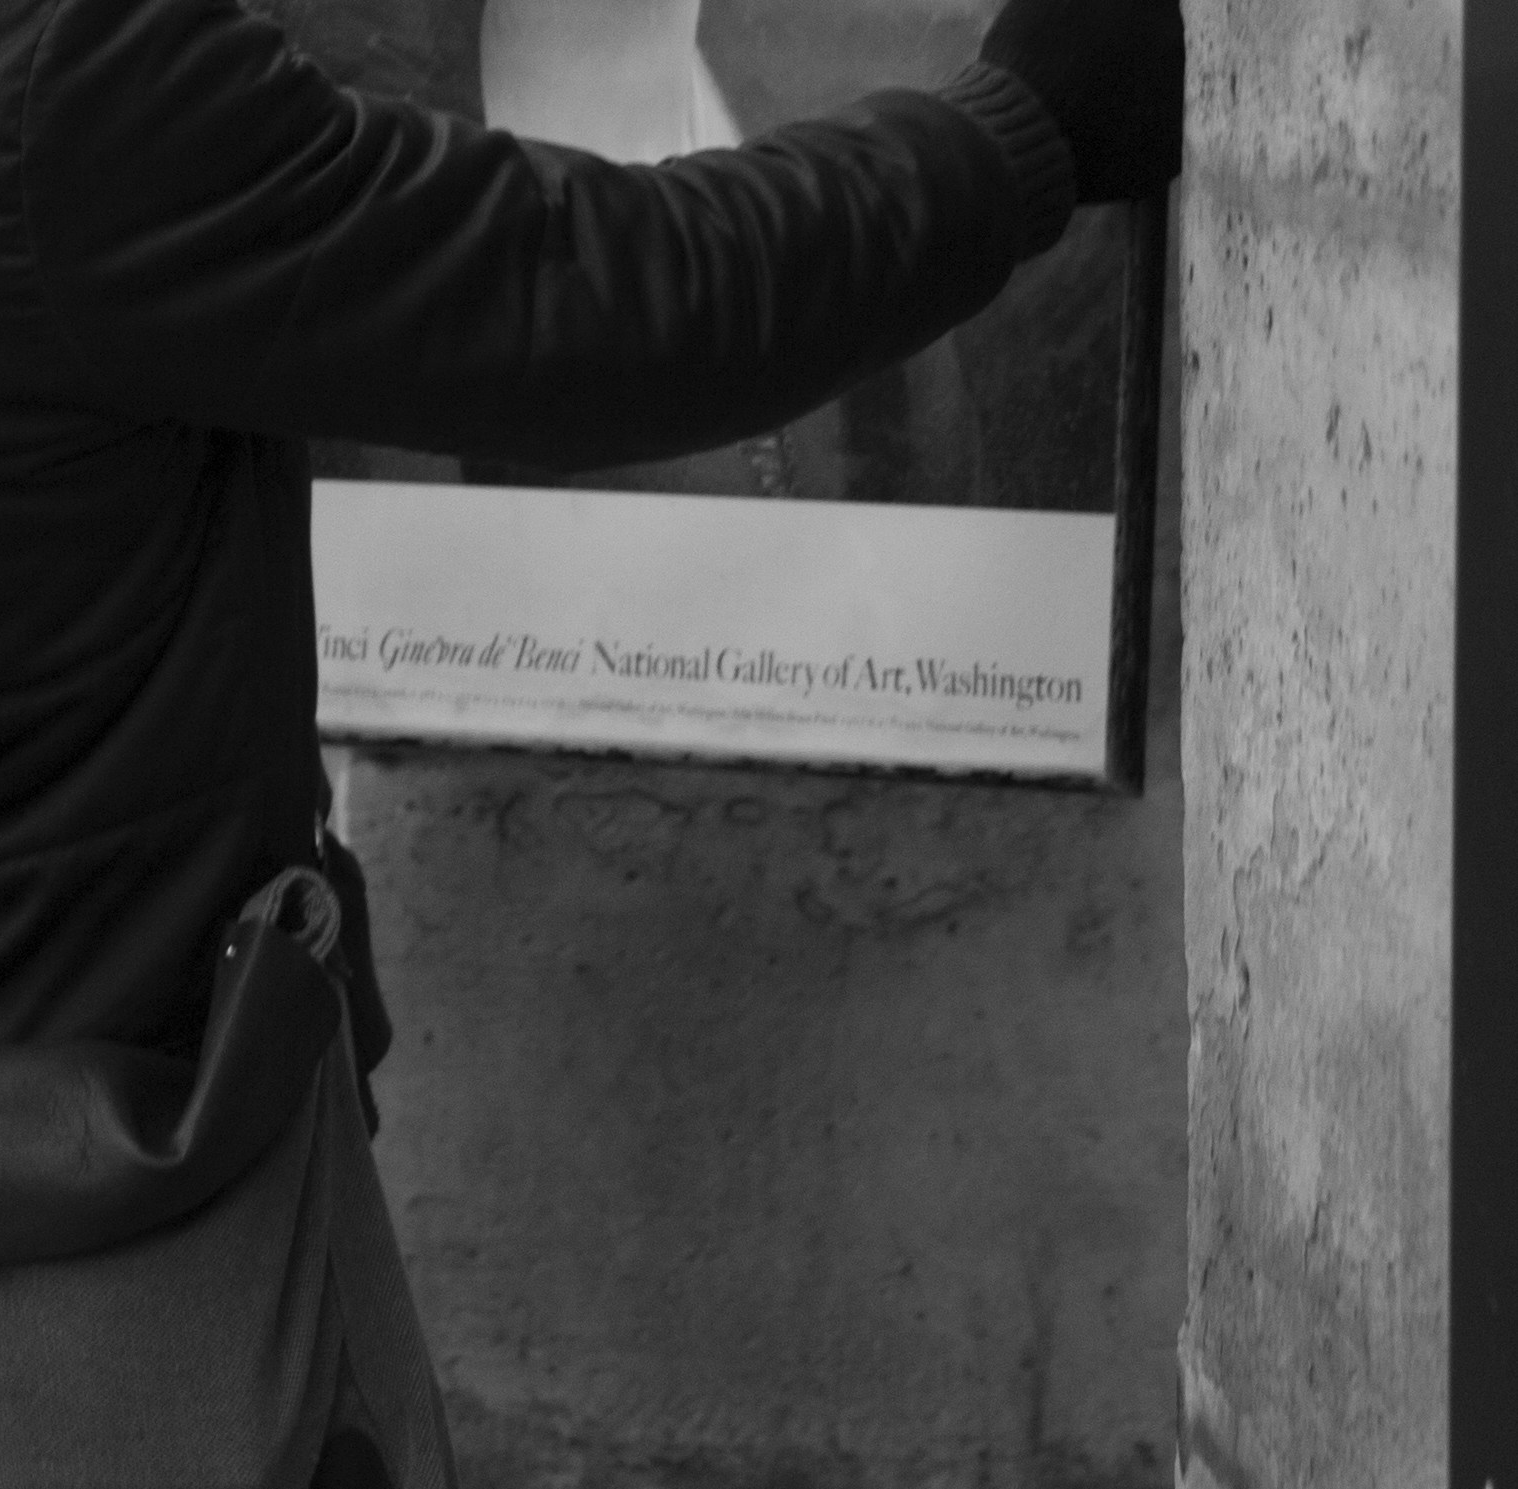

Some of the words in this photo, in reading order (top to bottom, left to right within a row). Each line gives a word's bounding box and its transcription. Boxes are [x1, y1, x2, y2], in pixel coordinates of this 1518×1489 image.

[320, 624, 369, 661] inci
[379, 628, 476, 673] Ginevra
[592, 639, 710, 681] National
[715, 646, 814, 698] Gallery
[822, 653, 855, 690] of
[853, 656, 912, 696] Art,
[915, 658, 1083, 710] Washington
